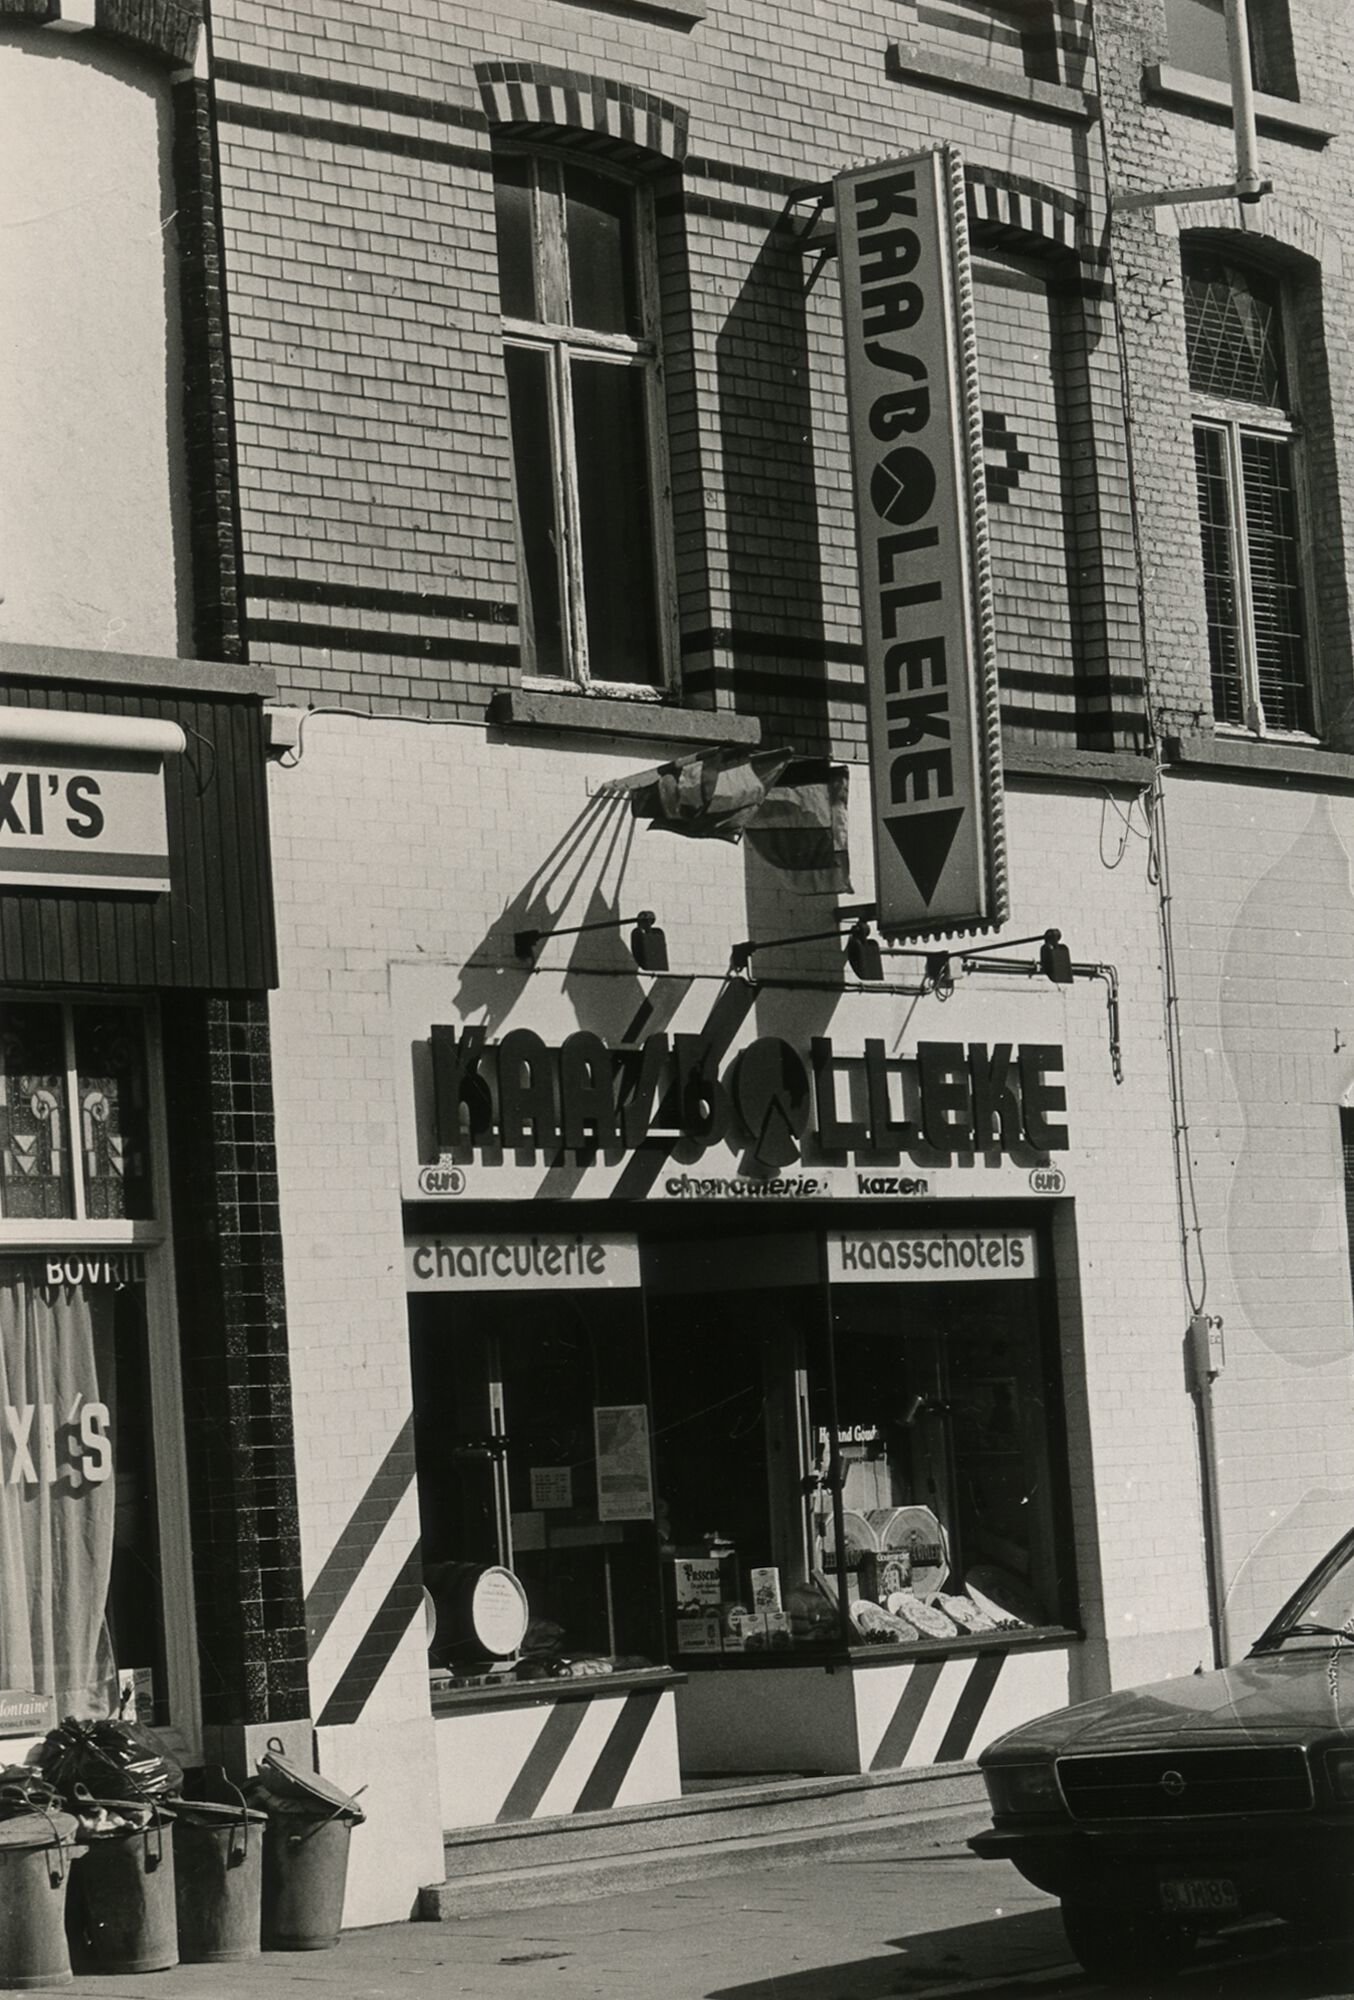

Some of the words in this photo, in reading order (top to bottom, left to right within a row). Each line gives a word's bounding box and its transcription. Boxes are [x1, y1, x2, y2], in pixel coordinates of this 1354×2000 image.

[46, 1254, 147, 1285] BOVRIL
[413, 1235, 606, 1279] charcuterie
[841, 1234, 1024, 1270] kaasschotels
